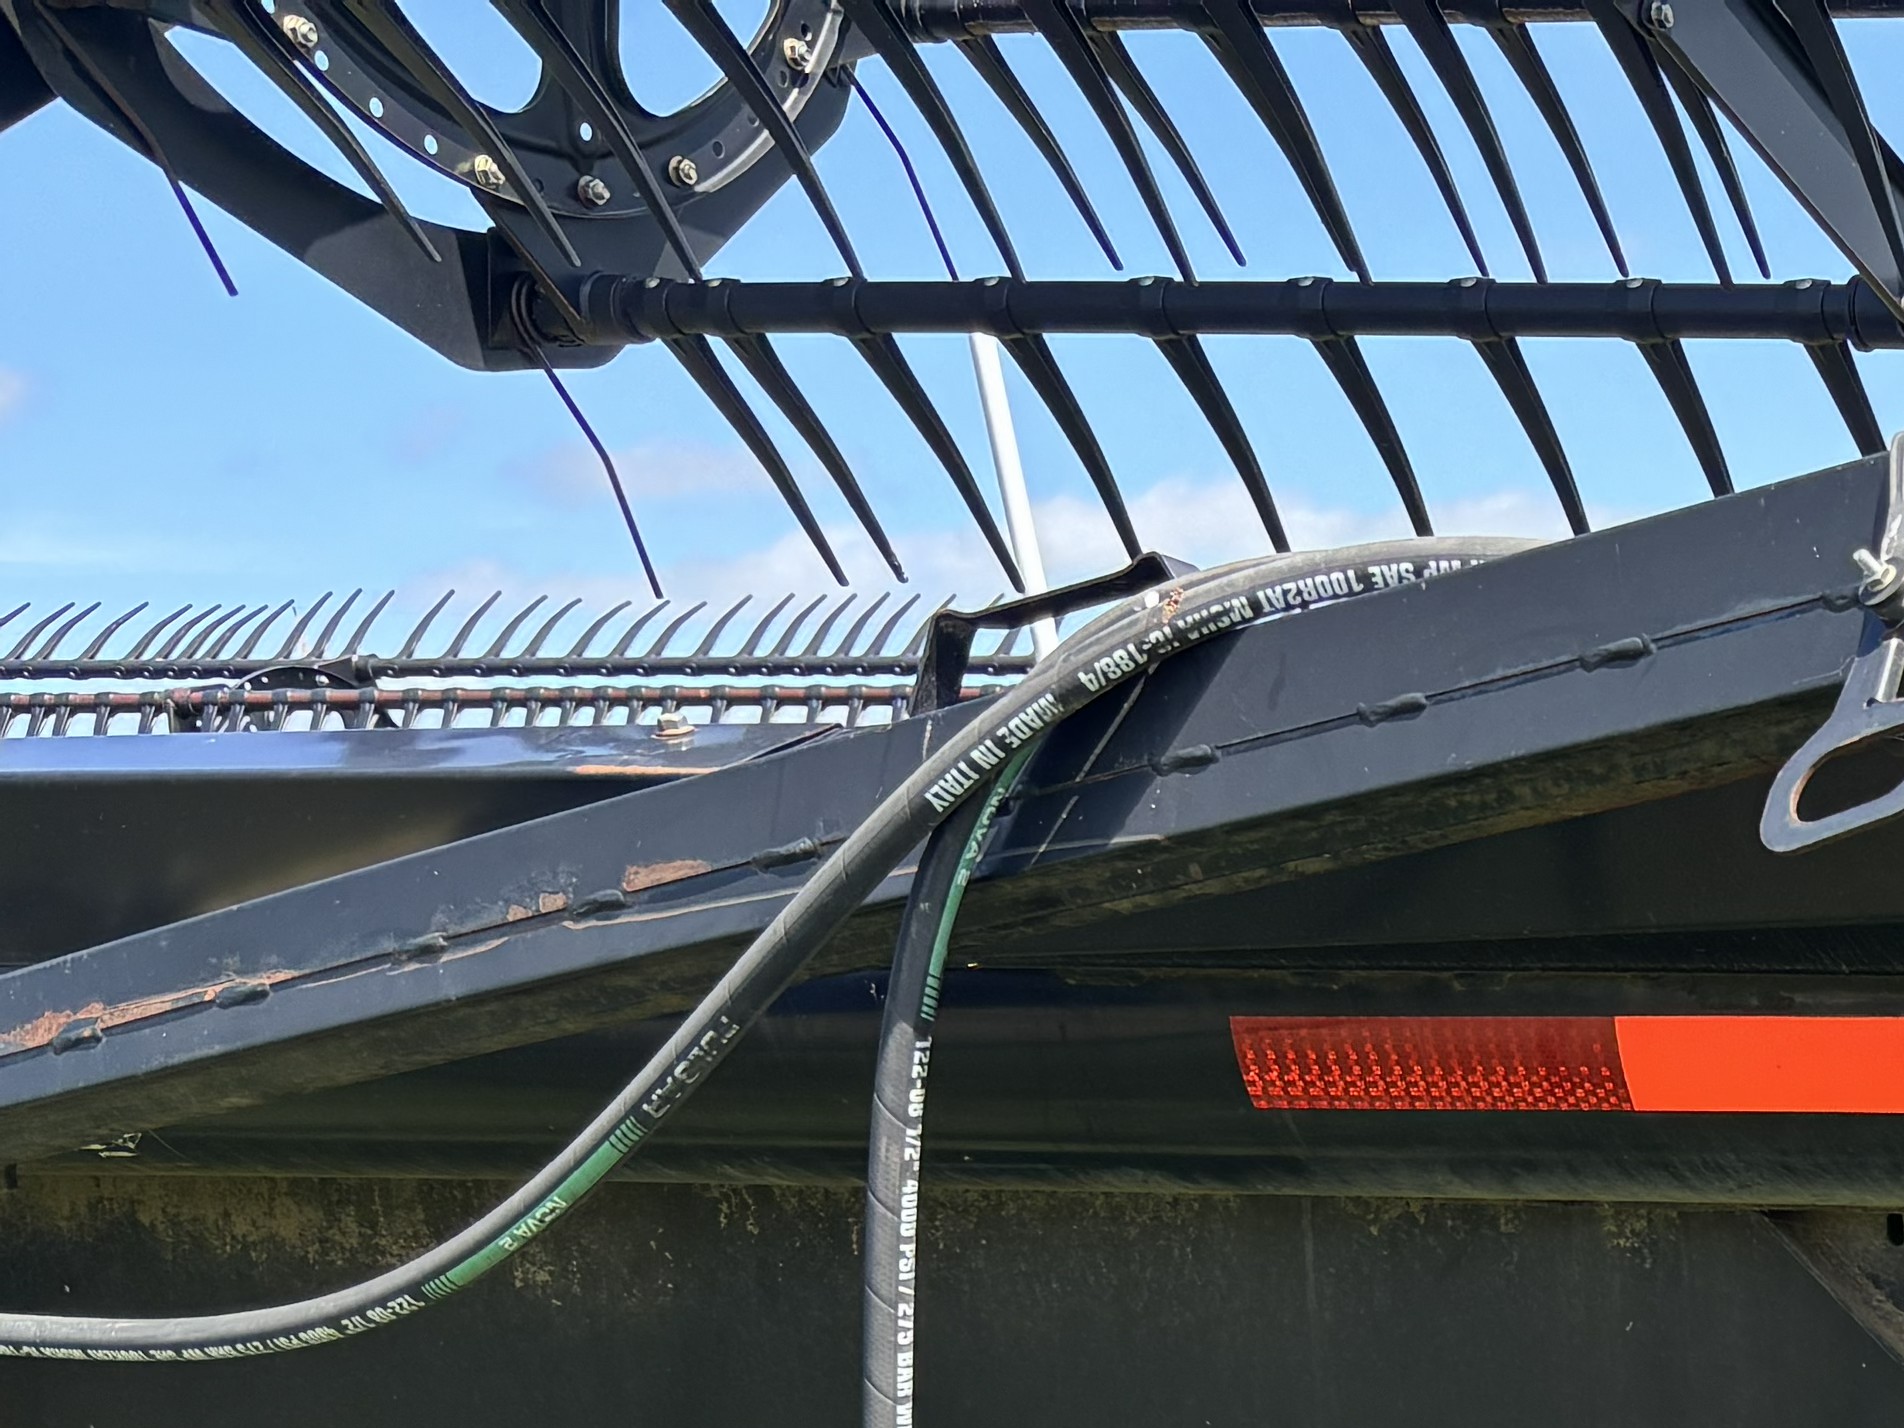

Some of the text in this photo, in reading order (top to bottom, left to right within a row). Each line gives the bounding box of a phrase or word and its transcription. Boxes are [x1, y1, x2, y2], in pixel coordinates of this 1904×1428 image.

[1257, 569, 1364, 613] 100R2AT
[1368, 562, 1417, 588] SAE
[996, 694, 1066, 749] MADE
[970, 739, 1006, 771] IN
[924, 760, 980, 813] ITALY
[965, 787, 1006, 862] NOVA
[514, 1196, 567, 1239] NOVA
[900, 1180, 918, 1238] 4000
[899, 1244, 916, 1280] PSI
[897, 1301, 914, 1345] 275
[897, 1351, 914, 1398] BAR
